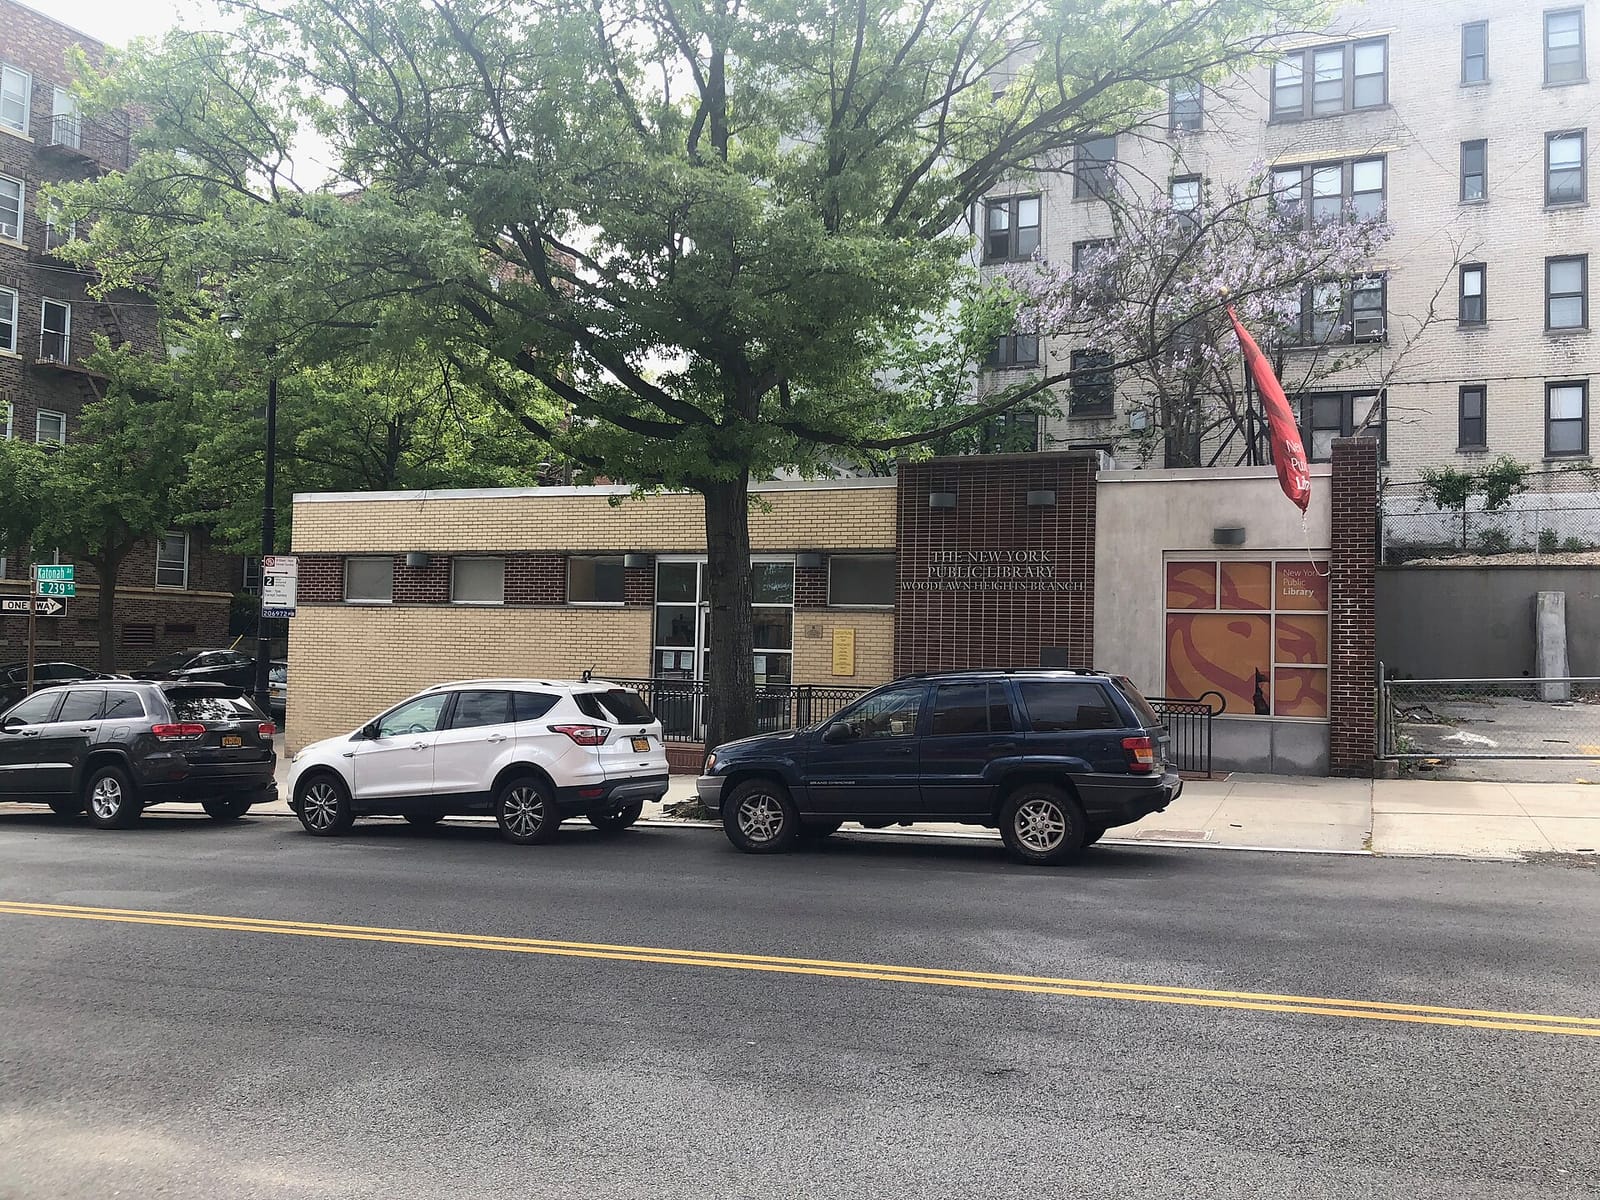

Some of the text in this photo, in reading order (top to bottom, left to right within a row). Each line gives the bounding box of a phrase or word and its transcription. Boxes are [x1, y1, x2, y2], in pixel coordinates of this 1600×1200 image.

[931, 550, 1051, 563] THE NEW YORK
[38, 568, 64, 579] Katonah
[928, 566, 1055, 578] PUBLIC LIBRARY
[1283, 569, 1301, 577] New
[266, 577, 272, 586] 2
[902, 581, 1083, 591] WOODLAWN HEIGHTS BRANCH
[1283, 578, 1306, 586] Public
[39, 582, 73, 594] E 239 St
[1283, 588, 1314, 598] Library
[7, 601, 56, 610] ONE WAY
